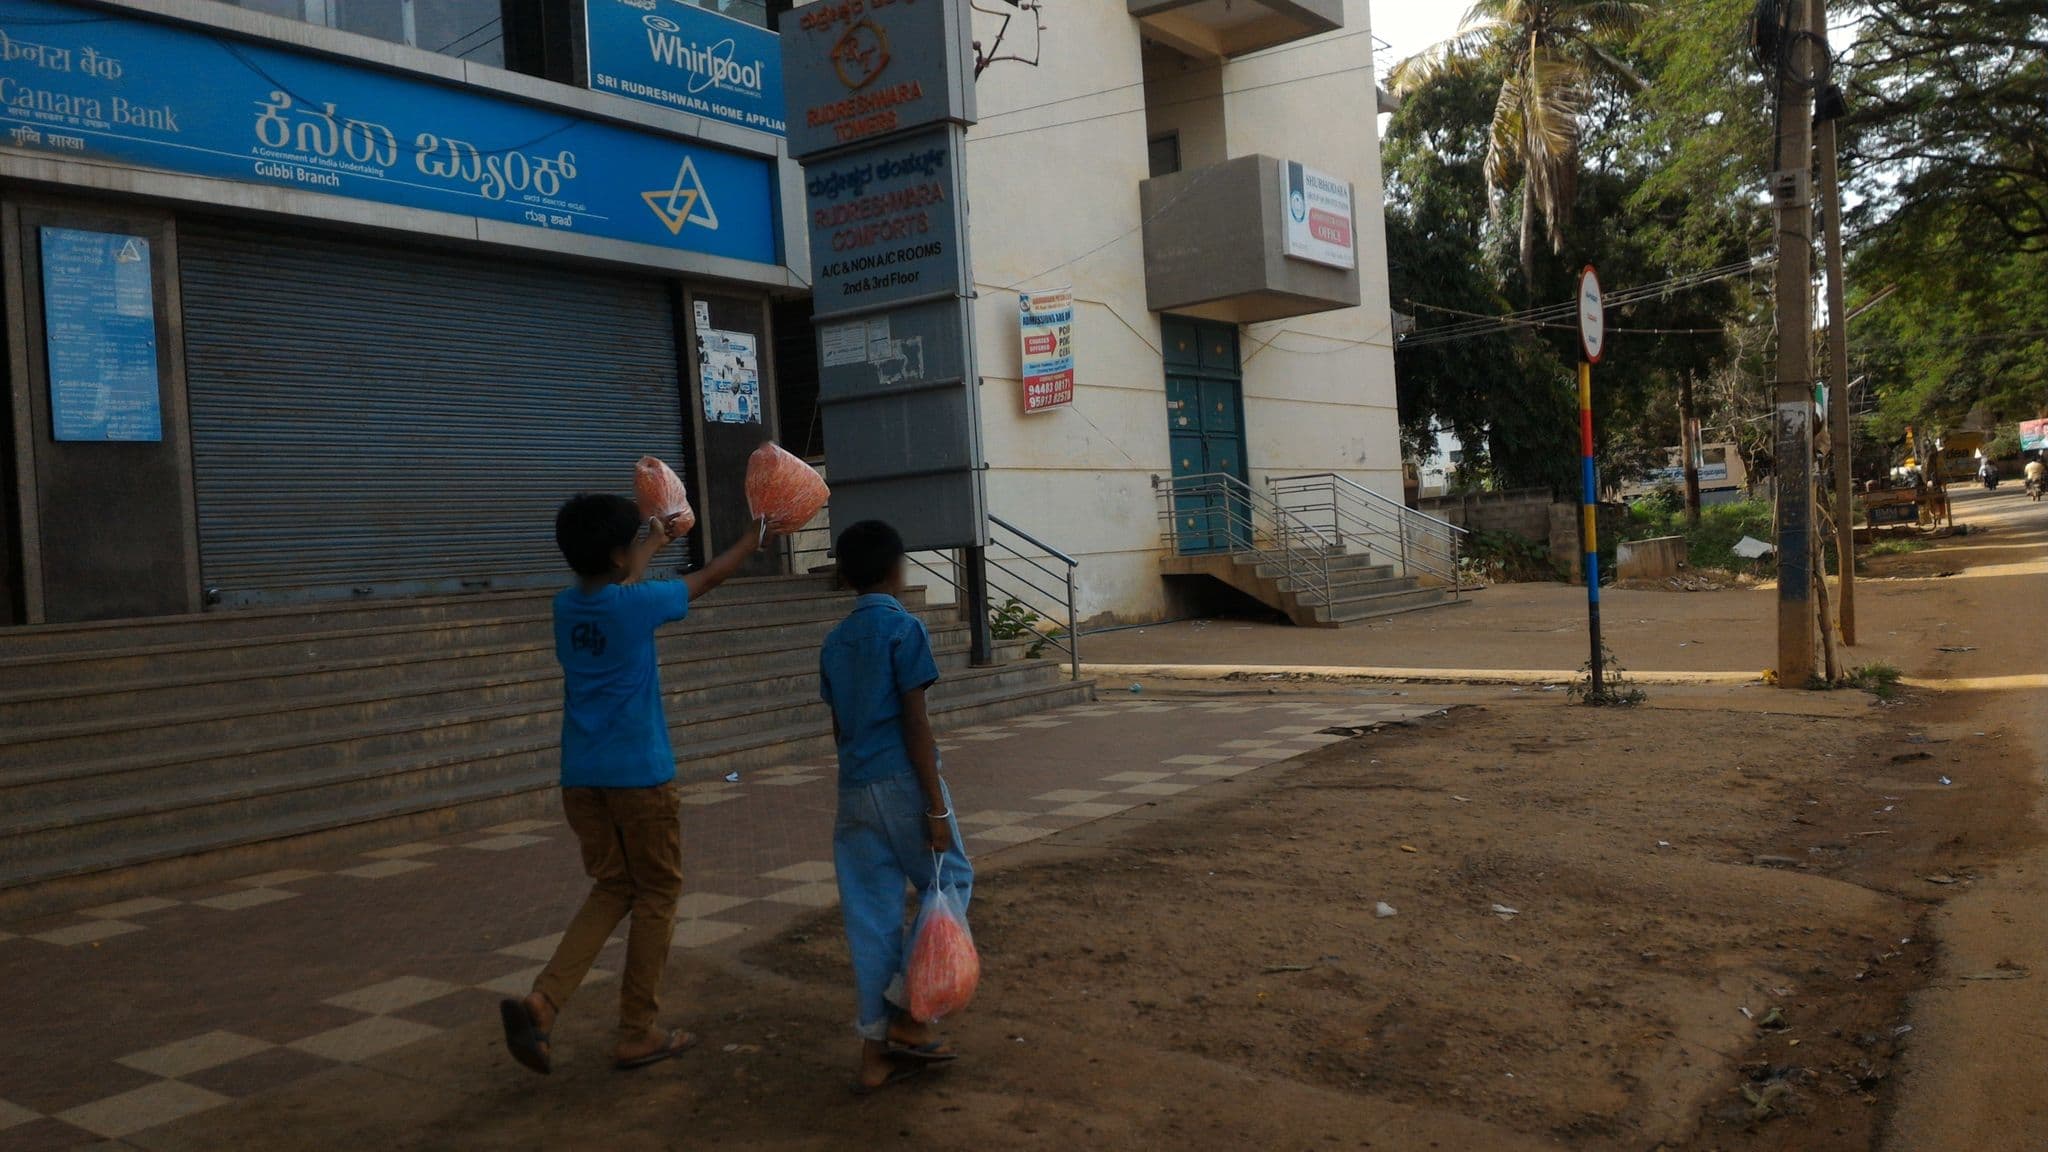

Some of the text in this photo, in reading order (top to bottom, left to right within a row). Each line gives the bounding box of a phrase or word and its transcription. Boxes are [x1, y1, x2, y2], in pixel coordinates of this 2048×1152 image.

[80, 46, 122, 80] बैंक
[647, 28, 761, 90] Whirlpool
[0, 77, 179, 132] Canara Bank
[597, 73, 617, 88] SRI
[621, 79, 710, 111] RUDRESHWARA
[712, 103, 744, 121] HOME
[806, 80, 922, 128] RUDRESHWARA
[48, 134, 84, 150] शाखा
[255, 161, 340, 187] Gubbi Branch
[260, 148, 307, 164] Government
[309, 155, 317, 165] of
[319, 158, 338, 168] India
[340, 161, 384, 177] Undertaking
[415, 132, 577, 200] ಬ್ಯಾಂಕ್
[815, 180, 944, 229] RUDRESHWARA
[832, 210, 928, 252] COMFORTS
[1318, 224, 1341, 242] OFFICE
[822, 262, 841, 279] A/C
[850, 254, 875, 272] NON
[876, 250, 897, 267] A/C
[897, 241, 942, 261] ROOMS
[842, 269, 920, 296] 2nd & 3rd Floor
